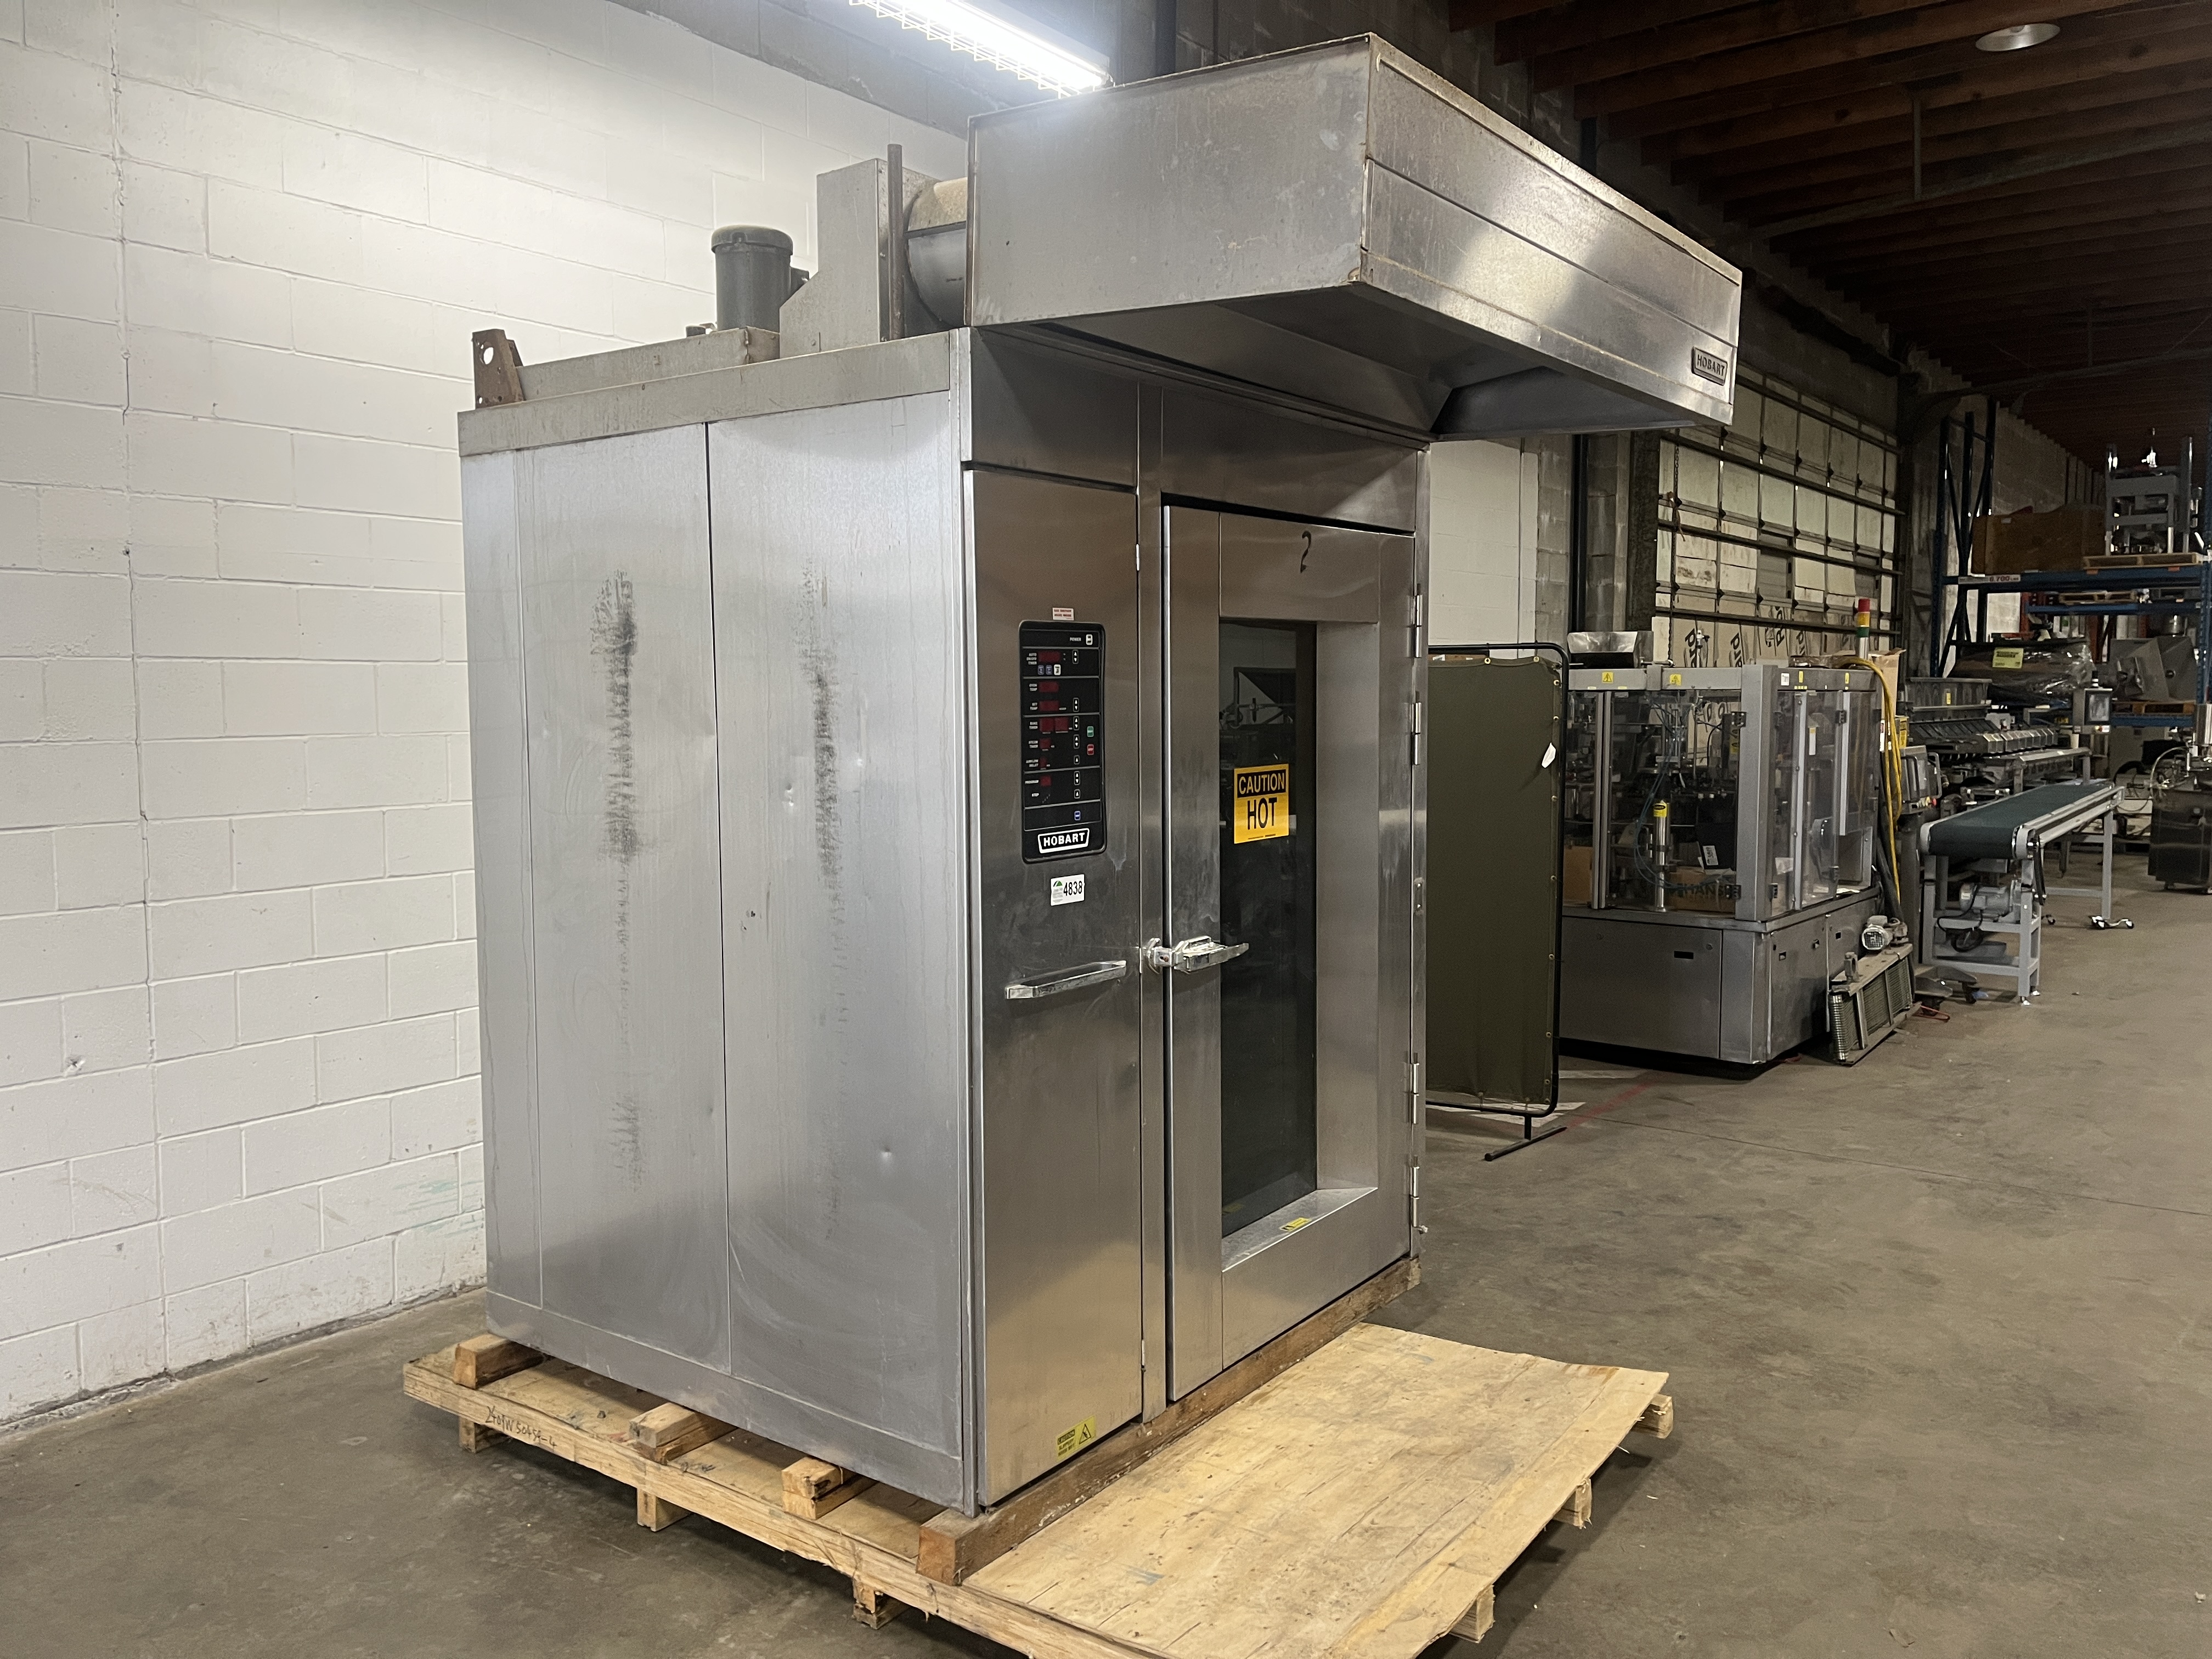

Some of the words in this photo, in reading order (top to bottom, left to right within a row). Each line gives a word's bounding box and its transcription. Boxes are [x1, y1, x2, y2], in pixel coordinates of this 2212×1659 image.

[1697, 354, 1725, 377] HOBART
[1238, 772, 1285, 794] CAUTION
[1247, 797, 1277, 830] HOT
[1043, 832, 1086, 847] HOBART
[1063, 881, 1083, 896] 4838
